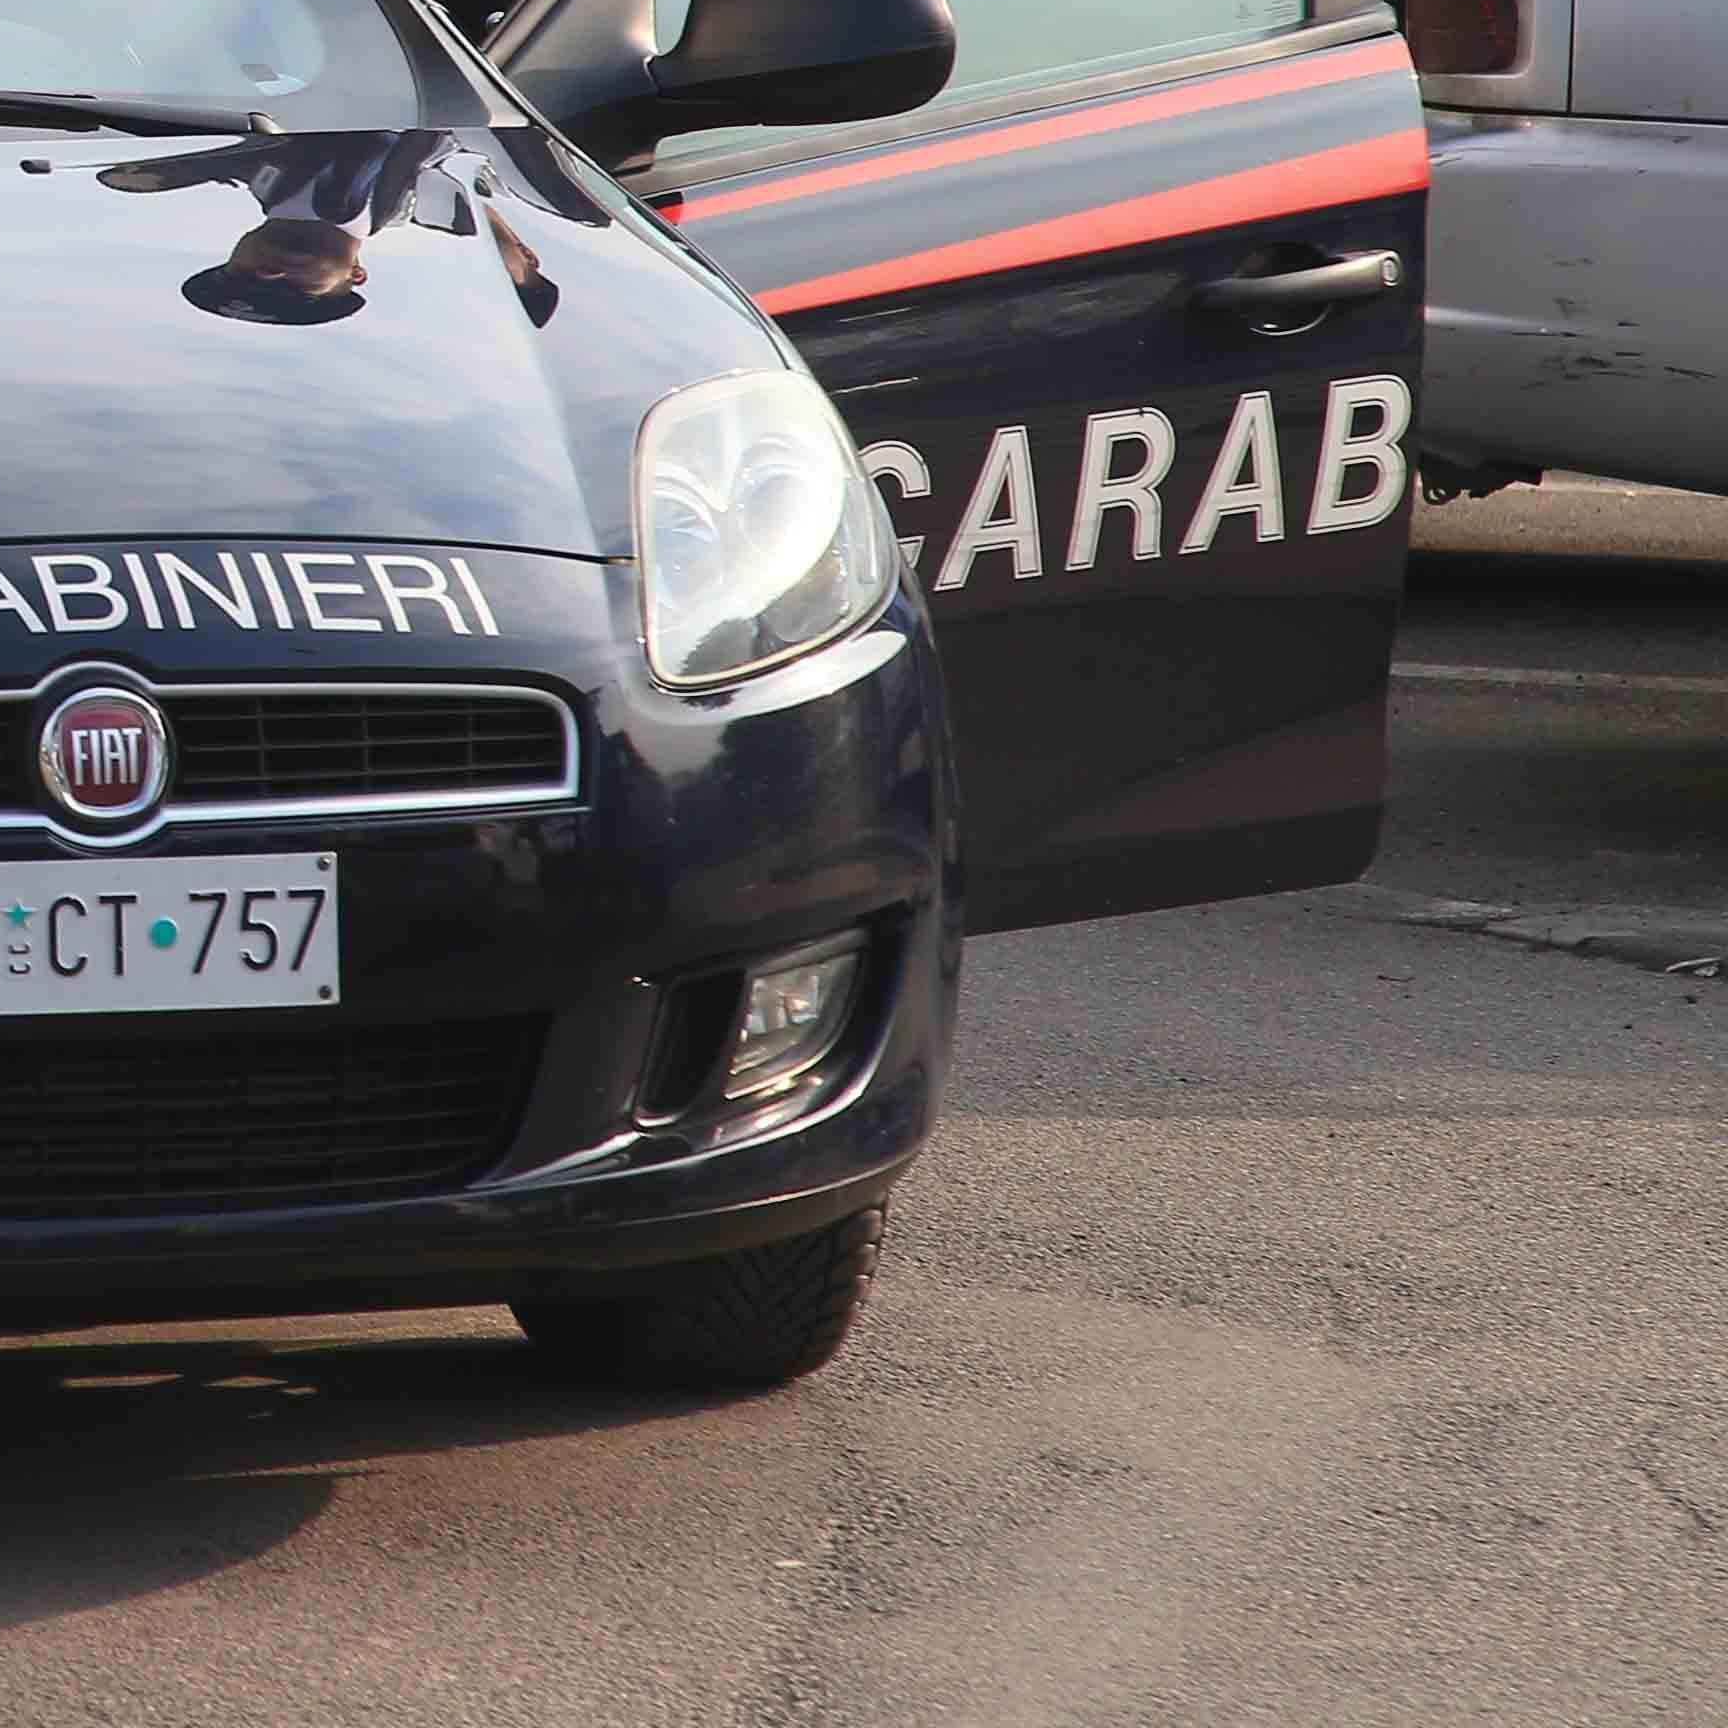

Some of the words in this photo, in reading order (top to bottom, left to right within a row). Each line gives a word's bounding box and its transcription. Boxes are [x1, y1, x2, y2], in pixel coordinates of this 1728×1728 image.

[71, 727, 143, 785] FIAT
[48, 894, 138, 976] CT
[188, 888, 327, 974] 757
